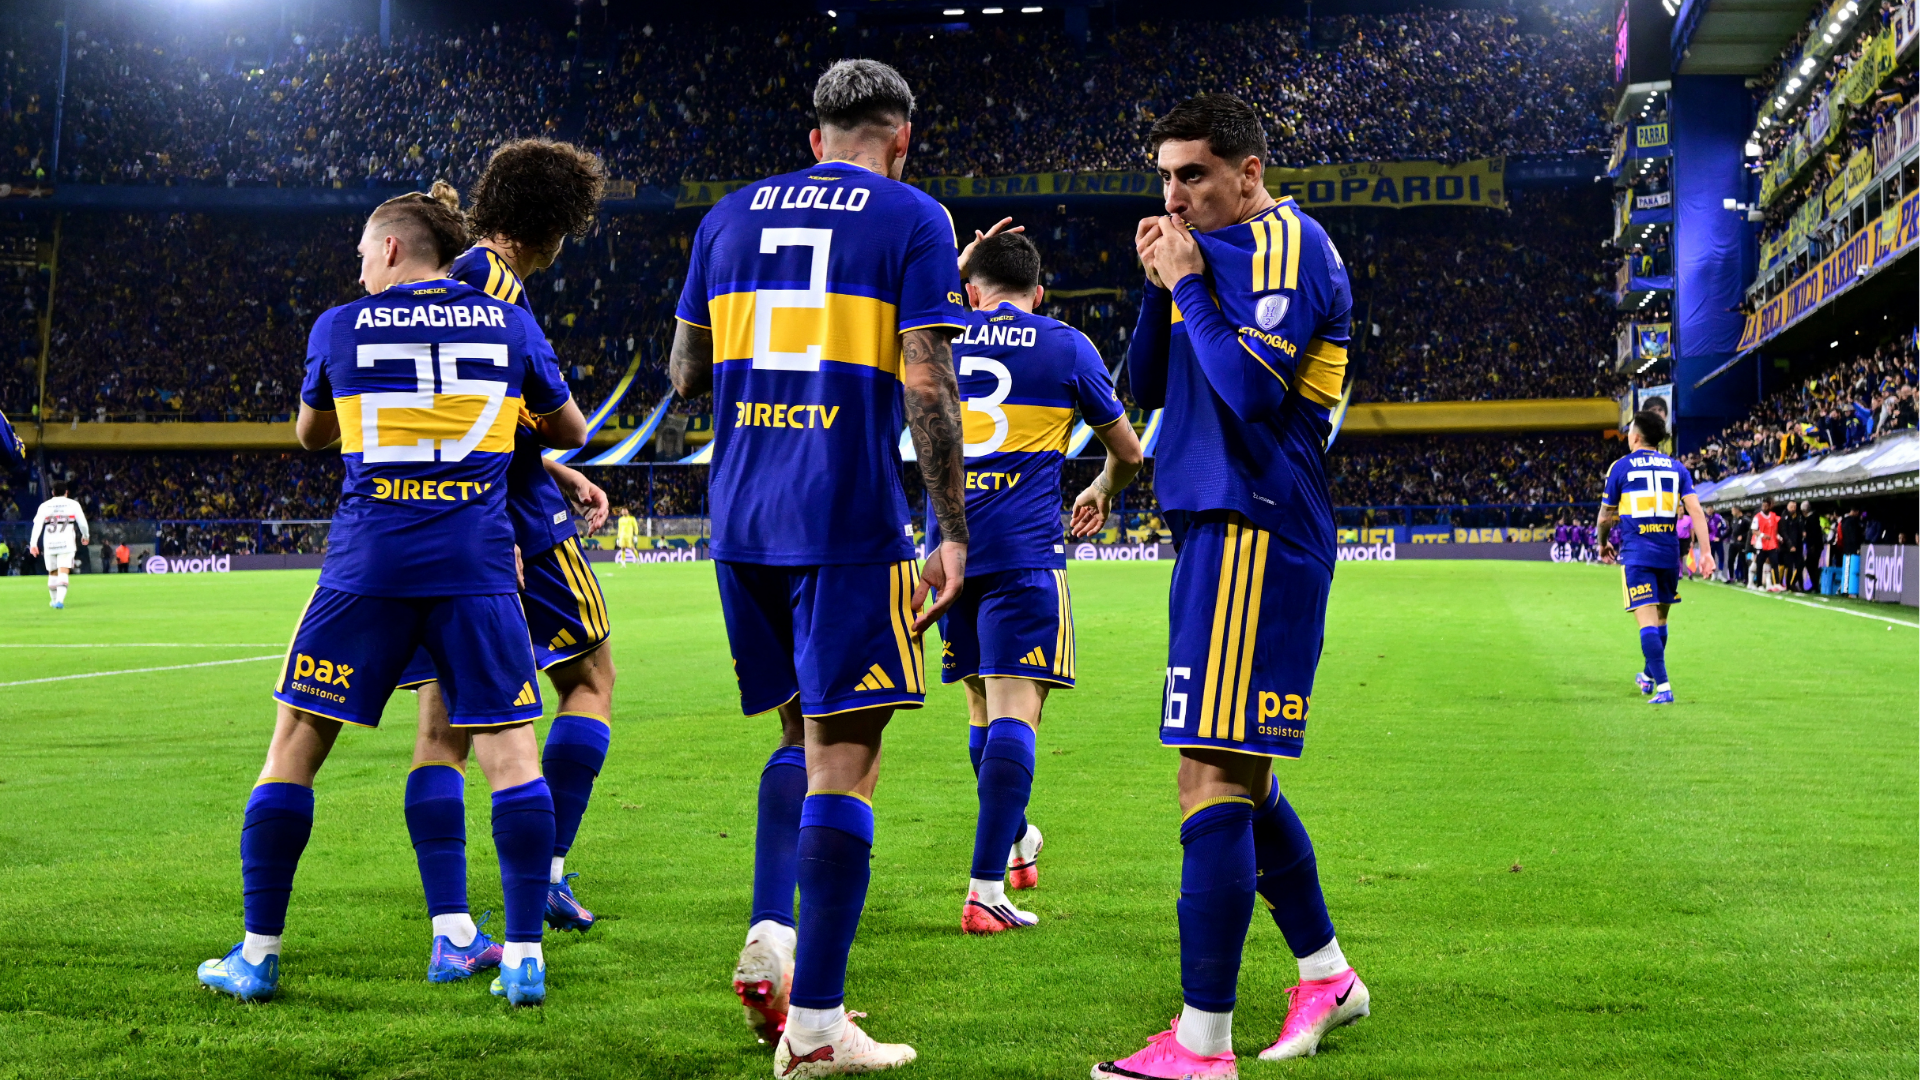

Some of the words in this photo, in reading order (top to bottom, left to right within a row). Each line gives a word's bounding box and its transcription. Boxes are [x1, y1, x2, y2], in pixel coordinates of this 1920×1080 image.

[1639, 126, 1666, 145] PARRA
[750, 186, 781, 210] DI
[780, 186, 870, 212] LOLLO
[1280, 174, 1481, 204] EOPARDI
[1759, 296, 1783, 338] BOCA
[1822, 230, 1869, 300] BARRIO
[752, 227, 833, 372] 2
[355, 304, 506, 329] ASCACIBAR
[1239, 327, 1297, 358] ETROGAR
[357, 343, 508, 463] 25
[735, 402, 840, 429] DIRECTV
[1629, 456, 1673, 468] VELASCO
[965, 471, 1021, 490] ECTV
[1627, 470, 1680, 518] 20
[47, 515, 68, 533] 37
[171, 554, 231, 572] world
[639, 547, 696, 562] world
[1099, 542, 1159, 561] world
[1336, 542, 1396, 561] world
[1875, 544, 1904, 593] world
[293, 653, 354, 689] pax
[291, 681, 346, 704] assistance
[1258, 725, 1305, 738] assistan
